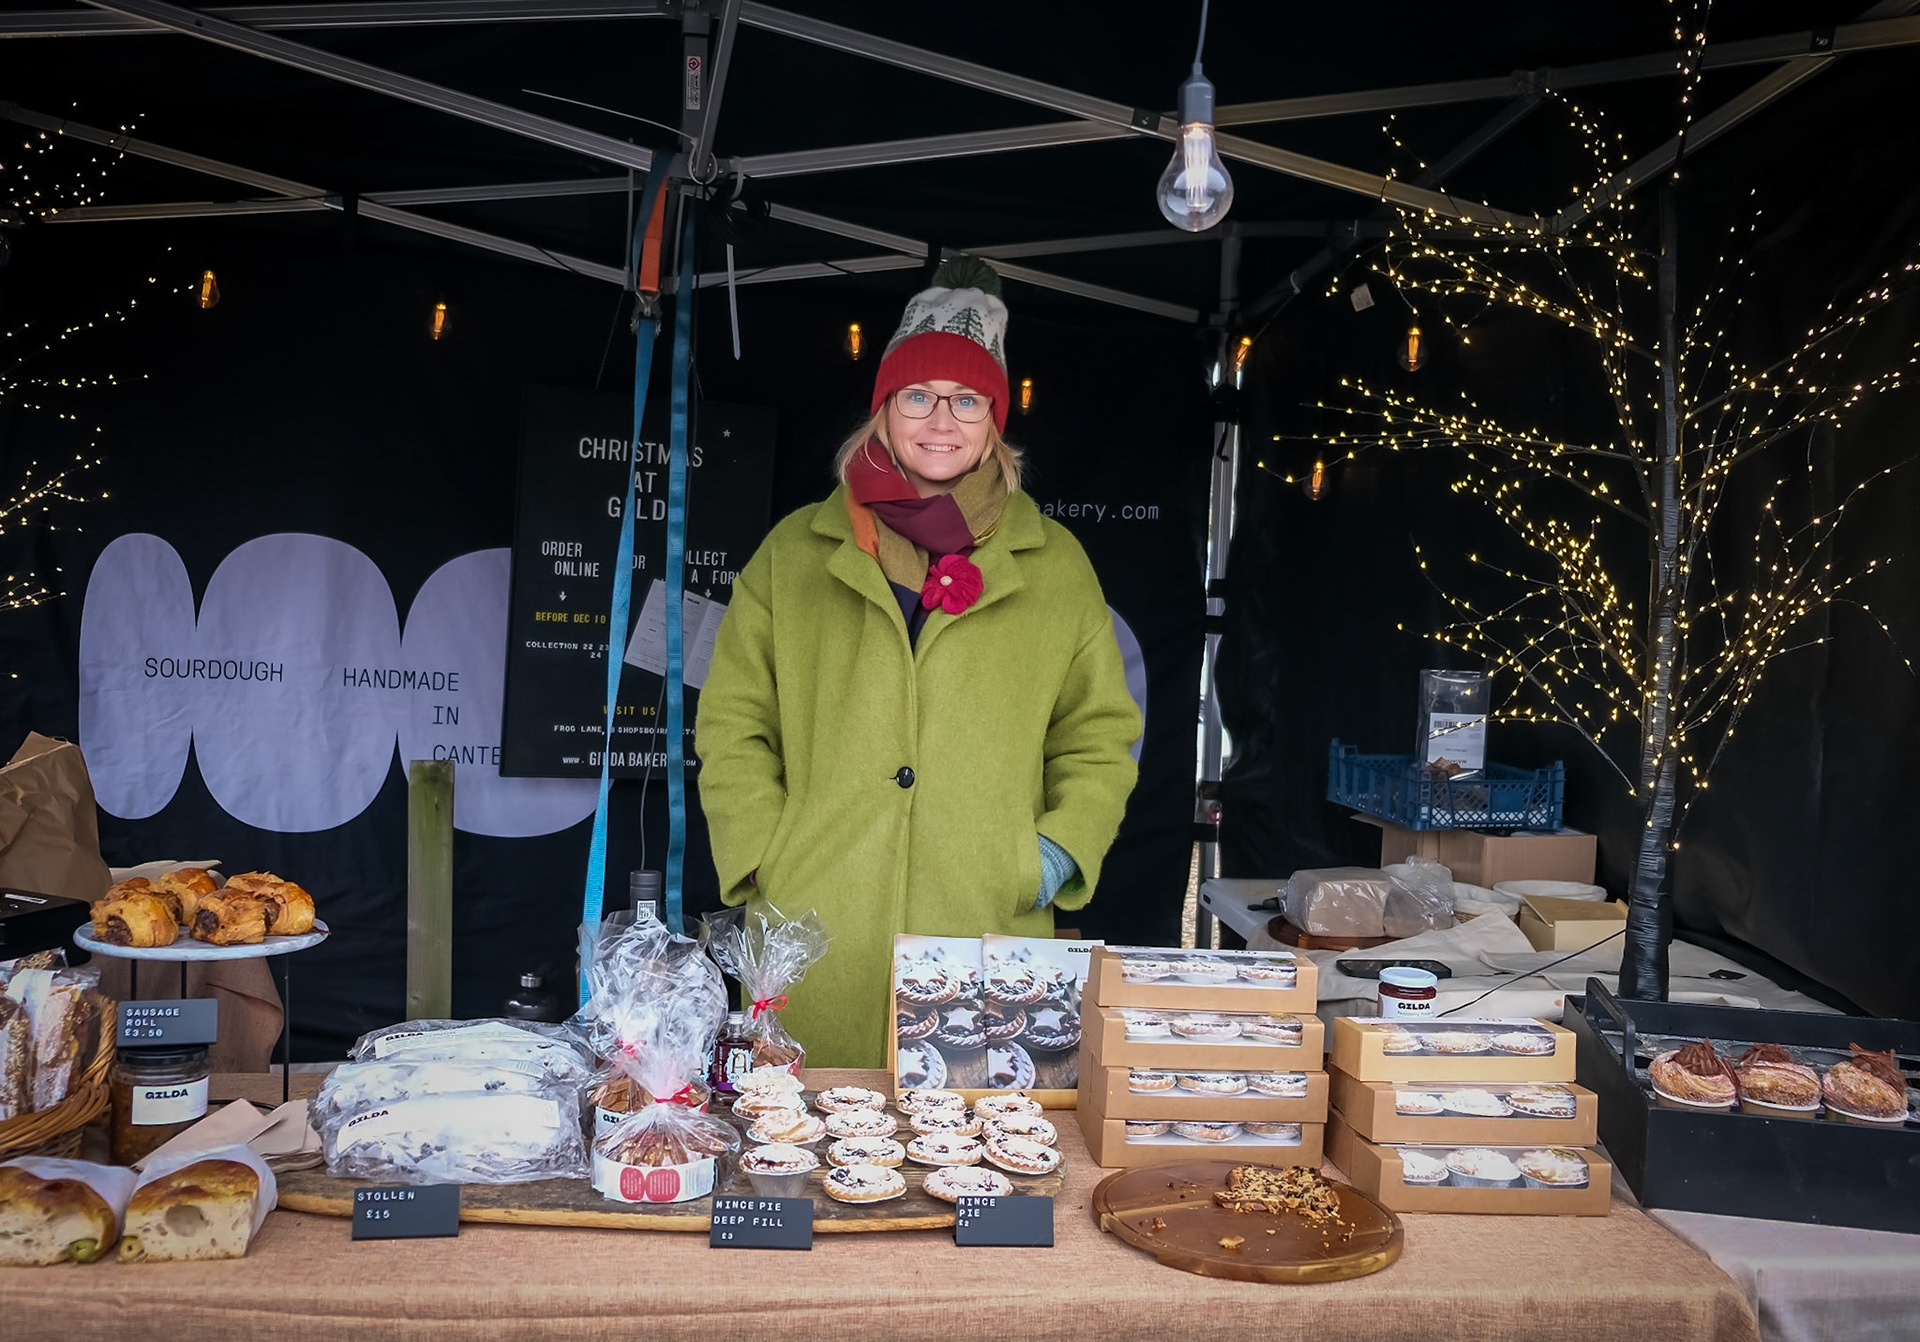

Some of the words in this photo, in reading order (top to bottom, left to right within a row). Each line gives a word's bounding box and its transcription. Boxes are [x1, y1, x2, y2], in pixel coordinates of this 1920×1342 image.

[579, 437, 704, 468] CHRISTMS
[634, 471, 658, 493] AT
[541, 541, 583, 558] ORDER
[554, 561, 600, 578] ONLINE
[691, 568, 699, 584] A
[712, 570, 740, 585] FOR
[535, 611, 569, 623] BEFORE
[573, 614, 591, 624] DEC
[594, 615, 607, 624] 10
[525, 641, 579, 650] COLLECTION
[582, 643, 594, 651] 22
[144, 657, 283, 683] SOURDOUGH
[343, 667, 460, 692] HANDMADE
[432, 705, 459, 725] IN
[603, 705, 635, 716] VSIT
[642, 706, 657, 716] US
[553, 725, 576, 733] FROG
[580, 725, 606, 736] LANE,
[628, 752, 668, 768] BAKER
[126, 1007, 180, 1017] SAUSAGE
[1397, 1002, 1431, 1010] GILDA
[126, 1019, 157, 1027] ROLL
[124, 1028, 163, 1037] £3.50
[145, 1088, 189, 1100] GILDA
[348, 1109, 390, 1128] GILDA
[357, 1190, 415, 1202] STOLLEN
[958, 1197, 996, 1207] MINCE
[716, 1200, 754, 1210] MINCE
[759, 1201, 782, 1212] PIE
[365, 1208, 391, 1219] £15
[959, 1208, 980, 1217] PIE
[713, 1215, 745, 1225] DEEP
[752, 1217, 783, 1227] FILL
[958, 1219, 970, 1227] £2
[721, 1232, 734, 1240] £3
